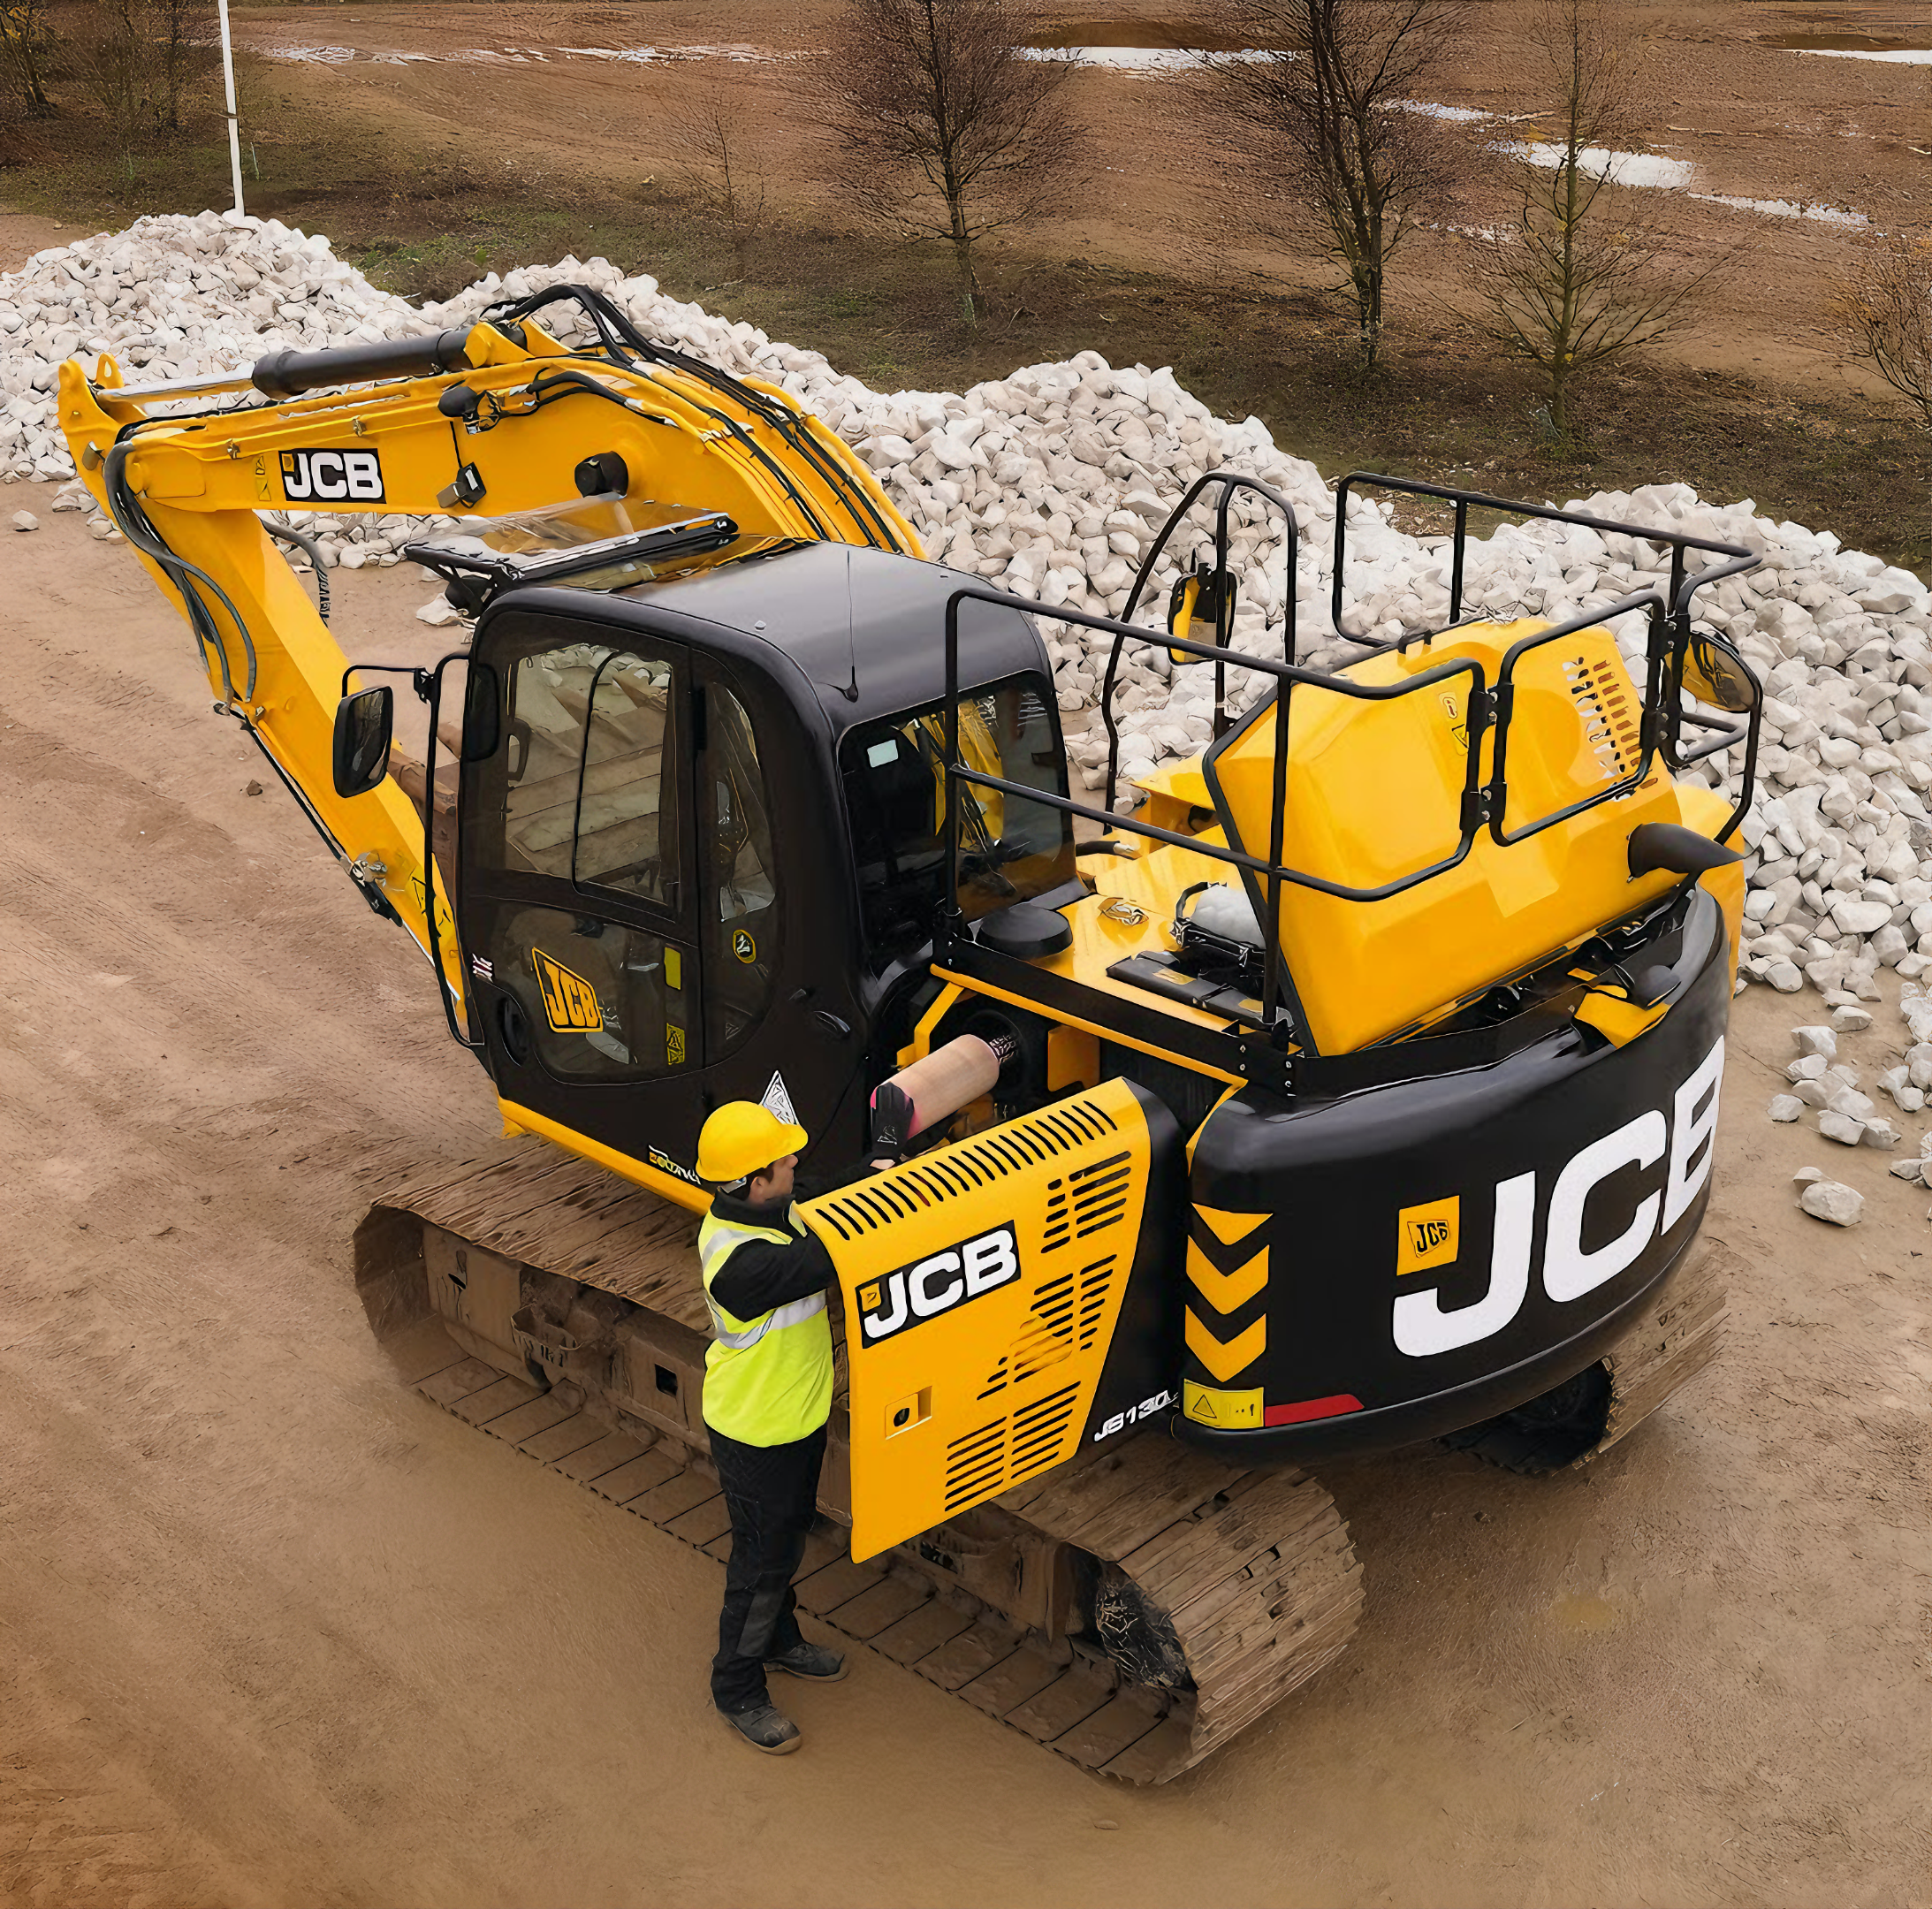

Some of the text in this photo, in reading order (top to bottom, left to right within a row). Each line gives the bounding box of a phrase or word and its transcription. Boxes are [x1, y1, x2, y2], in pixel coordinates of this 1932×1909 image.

[284, 452, 383, 498] JCB
[543, 959, 598, 1028] JCB
[1393, 1034, 1725, 1357] JCB
[863, 1229, 1017, 1339] JCB
